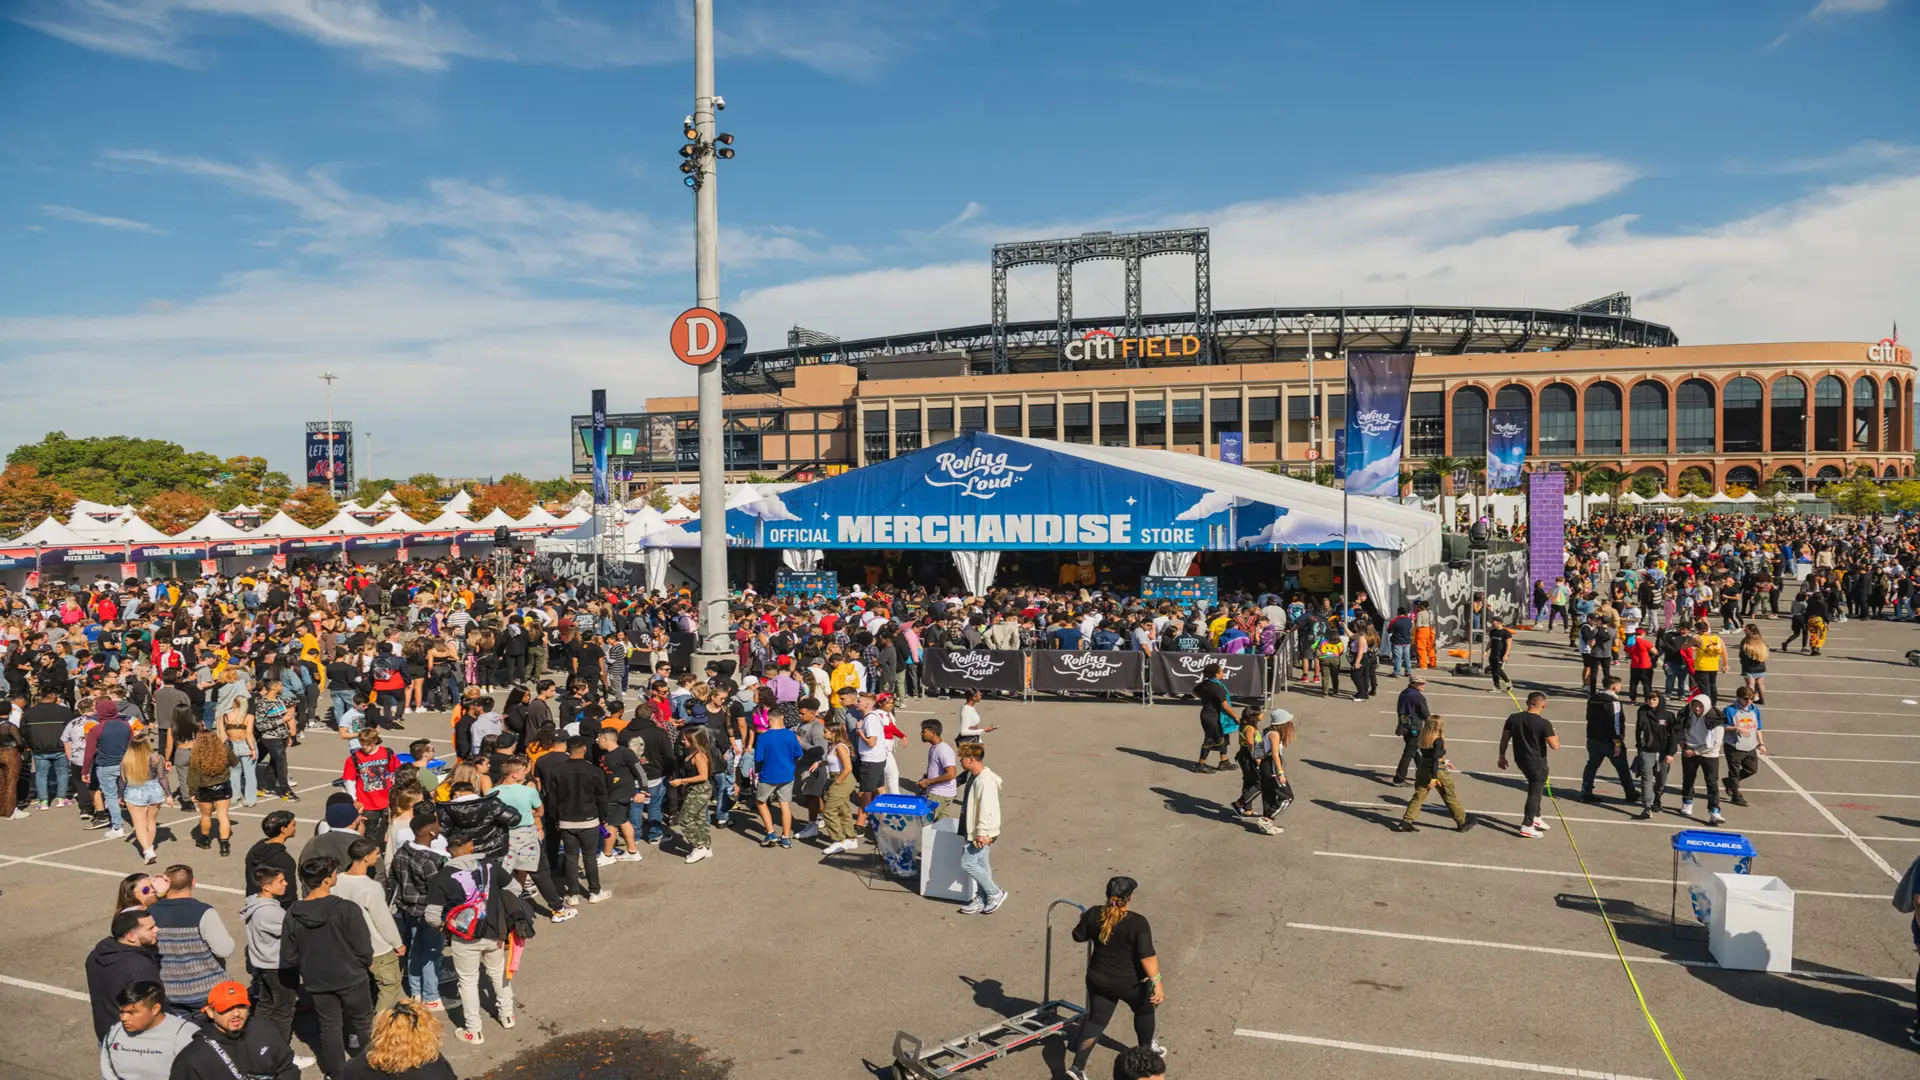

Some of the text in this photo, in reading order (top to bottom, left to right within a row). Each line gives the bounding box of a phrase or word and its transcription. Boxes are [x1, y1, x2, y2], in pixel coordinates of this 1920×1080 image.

[685, 316, 718, 357] D
[1065, 334, 1200, 361] citi FIELD
[333, 444, 345, 457] GO
[1309, 450, 1316, 459] B
[308, 460, 345, 478] Mts
[936, 447, 1032, 479] Rolling
[925, 471, 1014, 500] Loud
[770, 514, 1195, 544] OFFICIAL MERCHANDISE STORE
[63, 553, 106, 562] PIZZA SLICES
[143, 546, 196, 556] VEGGIE PIZZA
[172, 637, 194, 645] OFF
[949, 651, 1005, 668] Rolling
[1061, 652, 1122, 669] Rolling
[942, 663, 993, 681] Loud
[1053, 665, 1110, 683] Loud
[875, 802, 916, 810] RECYCLABLES
[1686, 839, 1742, 850] RECYCLABLES
[113, 1042, 163, 1056] Champion
